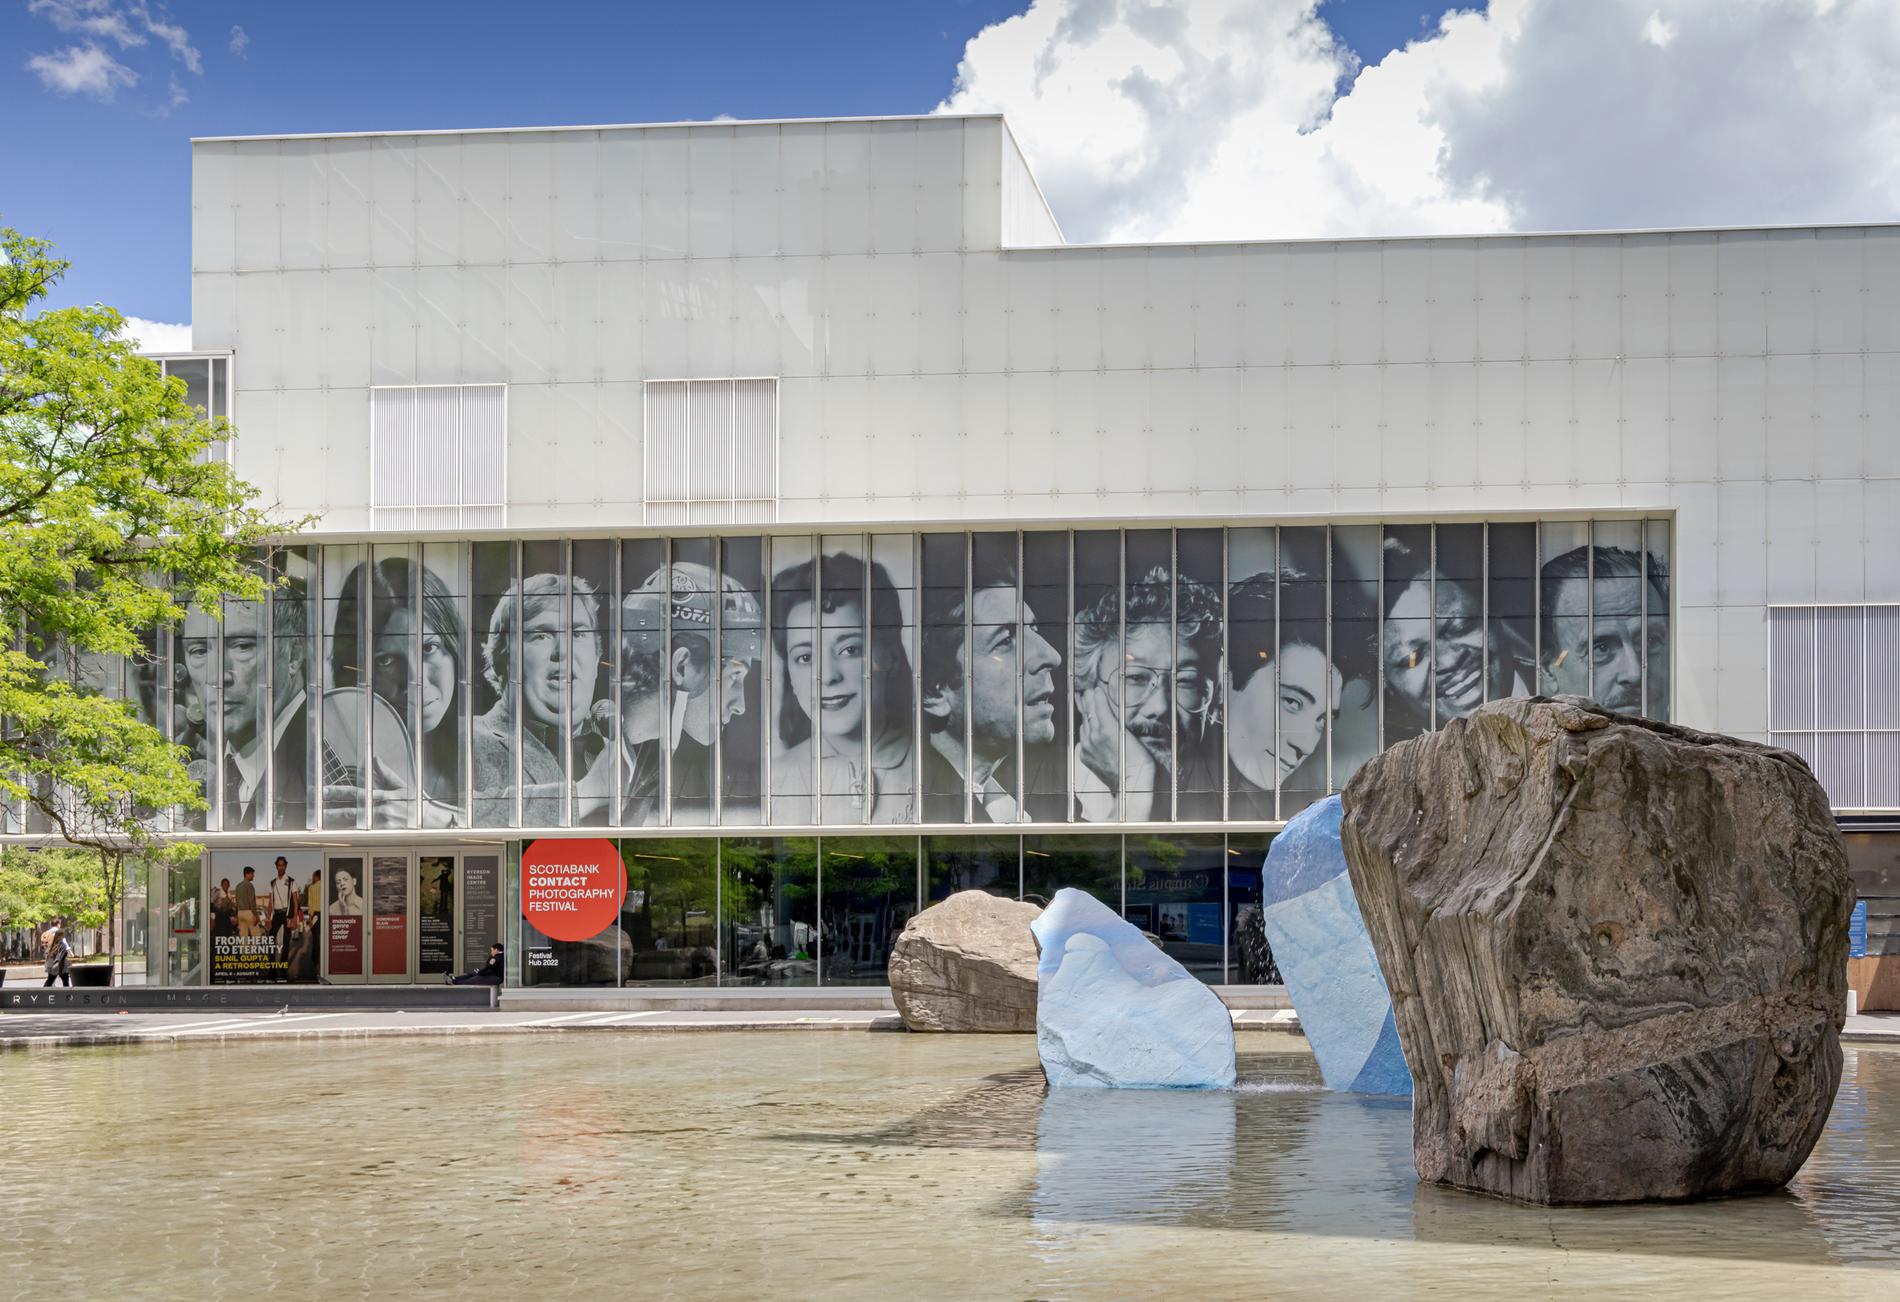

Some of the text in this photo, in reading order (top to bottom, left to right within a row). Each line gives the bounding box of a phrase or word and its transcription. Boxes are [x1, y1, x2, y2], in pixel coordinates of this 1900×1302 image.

[529, 864, 600, 875] SCOTIABANK
[529, 877, 588, 886] CONTACT
[529, 889, 615, 899] PHOTOGRAPHY
[529, 901, 578, 911] FESTIVAL
[215, 935, 275, 946] FROM HERE
[215, 945, 284, 955] TO ETERNITY
[215, 954, 270, 962] SUNIL GUPTA
[215, 961, 289, 970] A RETROSPECTIVE
[12, 994, 128, 1005] RYERSON
